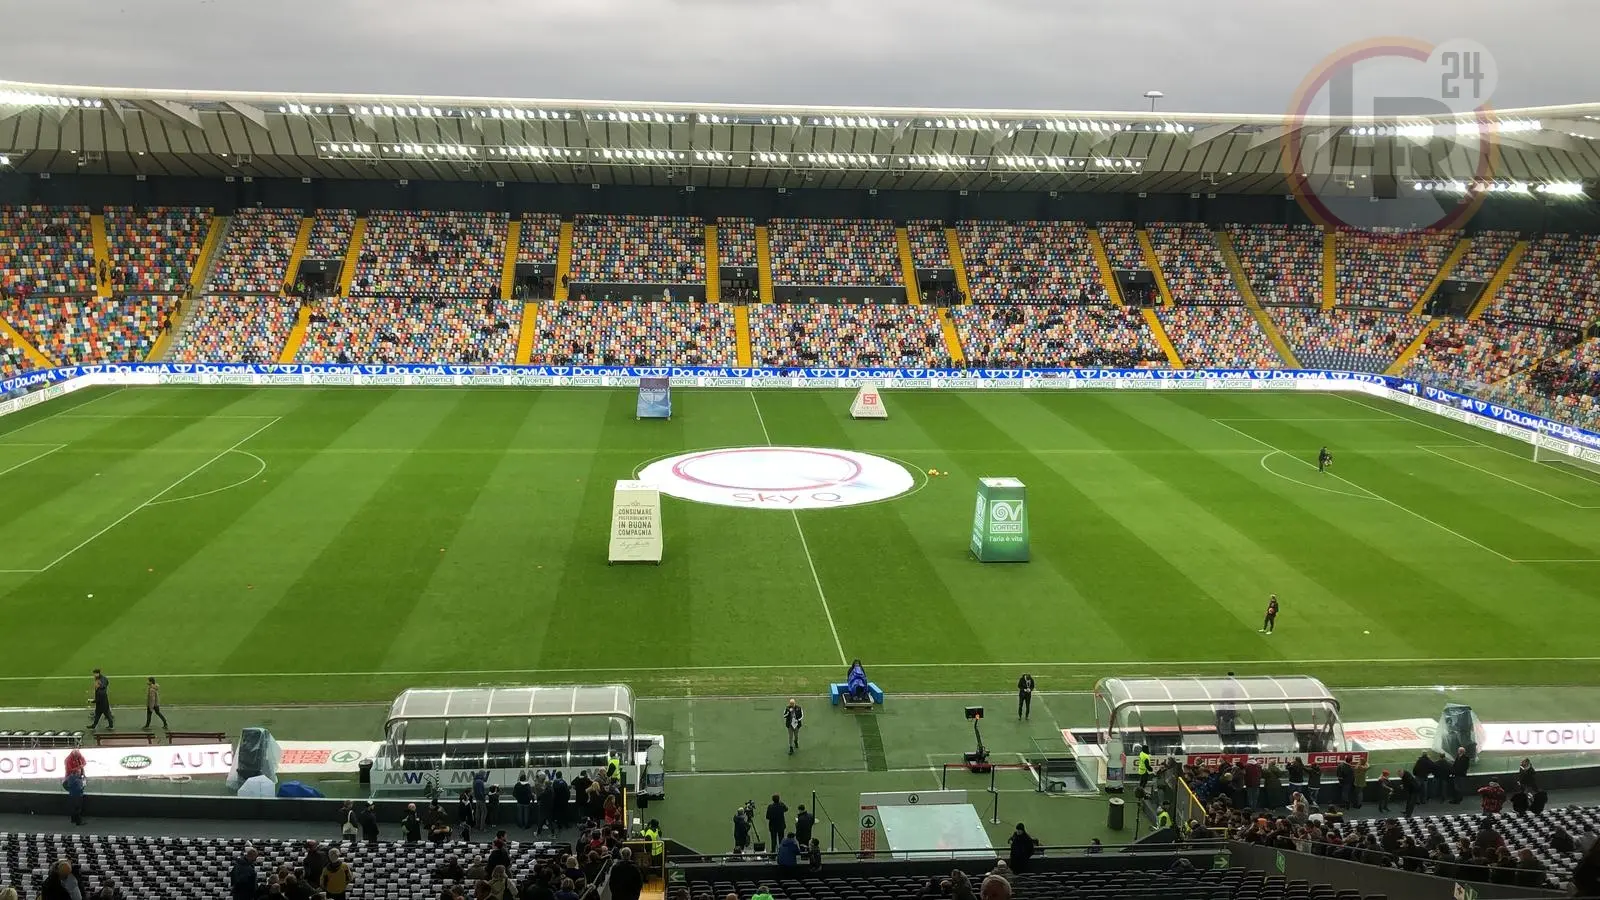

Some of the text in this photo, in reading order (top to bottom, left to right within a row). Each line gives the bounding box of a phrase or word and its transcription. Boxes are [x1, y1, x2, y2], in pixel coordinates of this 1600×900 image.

[106, 364, 169, 374] DOLOMIA
[196, 365, 255, 374] DOLOMIA
[302, 366, 361, 375] DOLOMIA
[387, 366, 446, 375] DOLOMIA
[573, 367, 630, 377] DOLOMIA
[673, 367, 728, 377] DOLOMIA
[849, 369, 903, 378] DOLOMIA
[1100, 370, 1154, 379] DOLOMIA
[1200, 370, 1251, 380] DOLOMIA
[1273, 371, 1328, 380] DOLOMIA
[1504, 409, 1545, 428] DOLOMIA
[812, 492, 843, 503] Q
[1502, 724, 1596, 745] AUTOPIÙ
